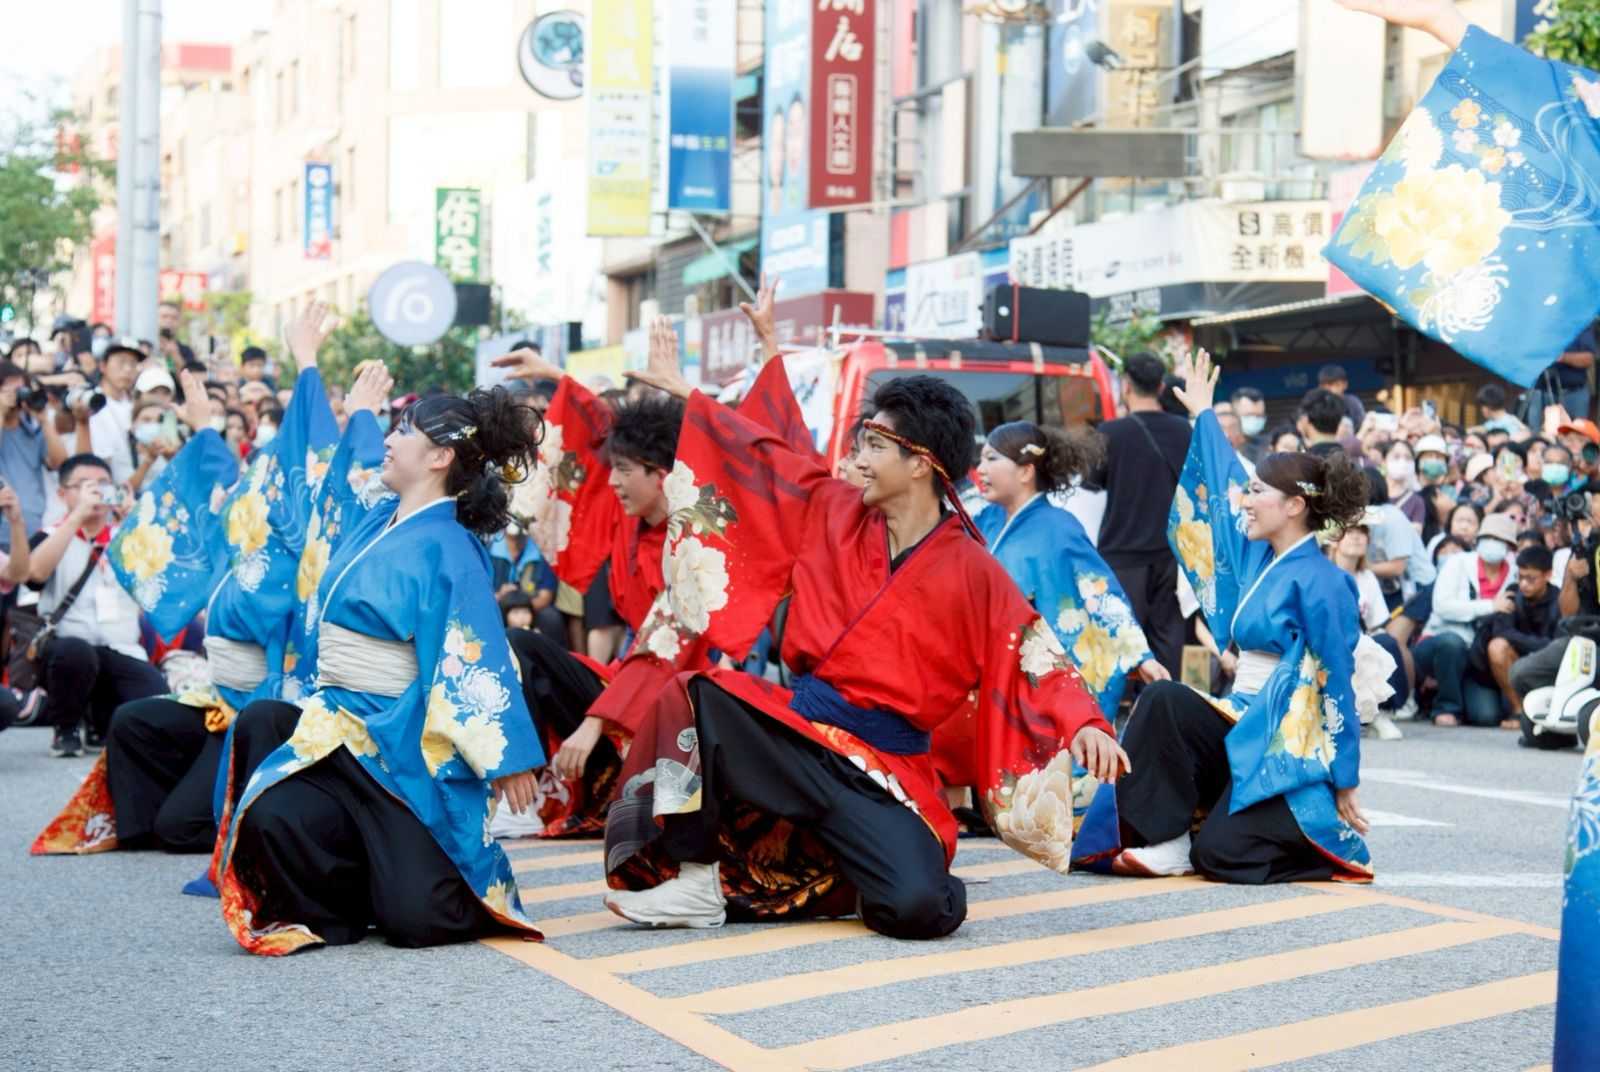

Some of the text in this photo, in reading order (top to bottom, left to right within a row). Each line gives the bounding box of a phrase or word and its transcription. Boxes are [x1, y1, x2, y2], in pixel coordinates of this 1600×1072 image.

[1272, 212, 1323, 236] 高價
[1231, 244, 1305, 270] 全新機
